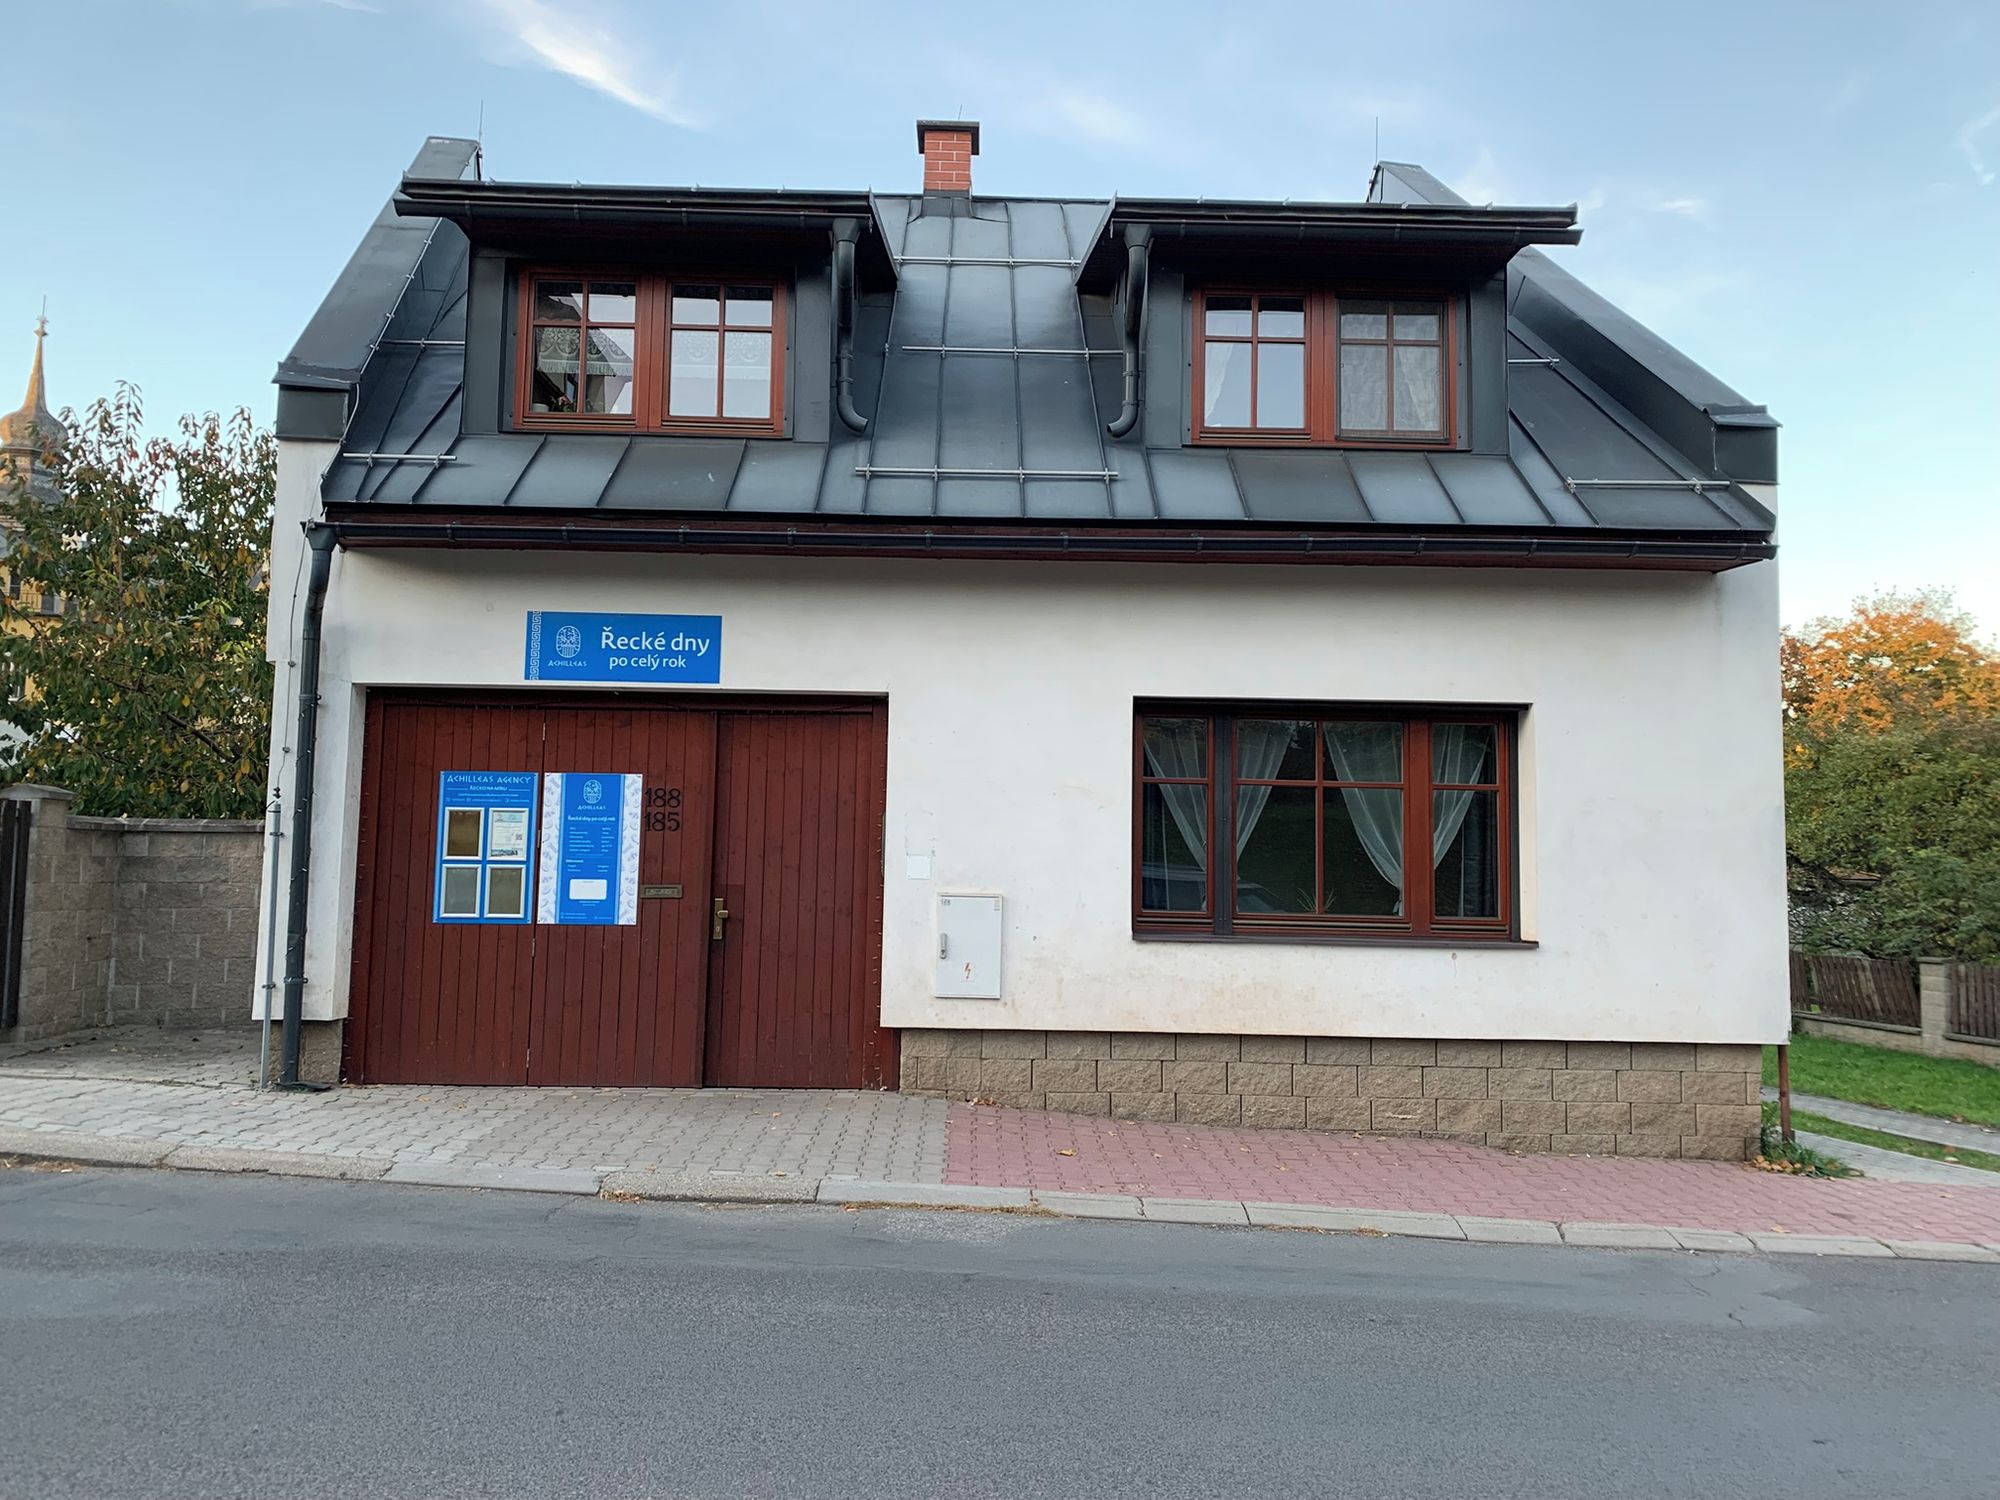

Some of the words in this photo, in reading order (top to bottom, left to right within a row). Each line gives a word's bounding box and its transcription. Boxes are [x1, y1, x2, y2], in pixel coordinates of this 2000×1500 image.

[601, 626, 666, 650] Řecké
[671, 632, 710, 657] dny
[609, 656, 628, 670] po
[631, 654, 660, 671] celý
[663, 655, 686, 668] rok
[446, 775, 494, 783] ACHILLEAS
[496, 776, 532, 784] AGENCY
[644, 787, 681, 809] 188
[644, 811, 681, 832] 185
